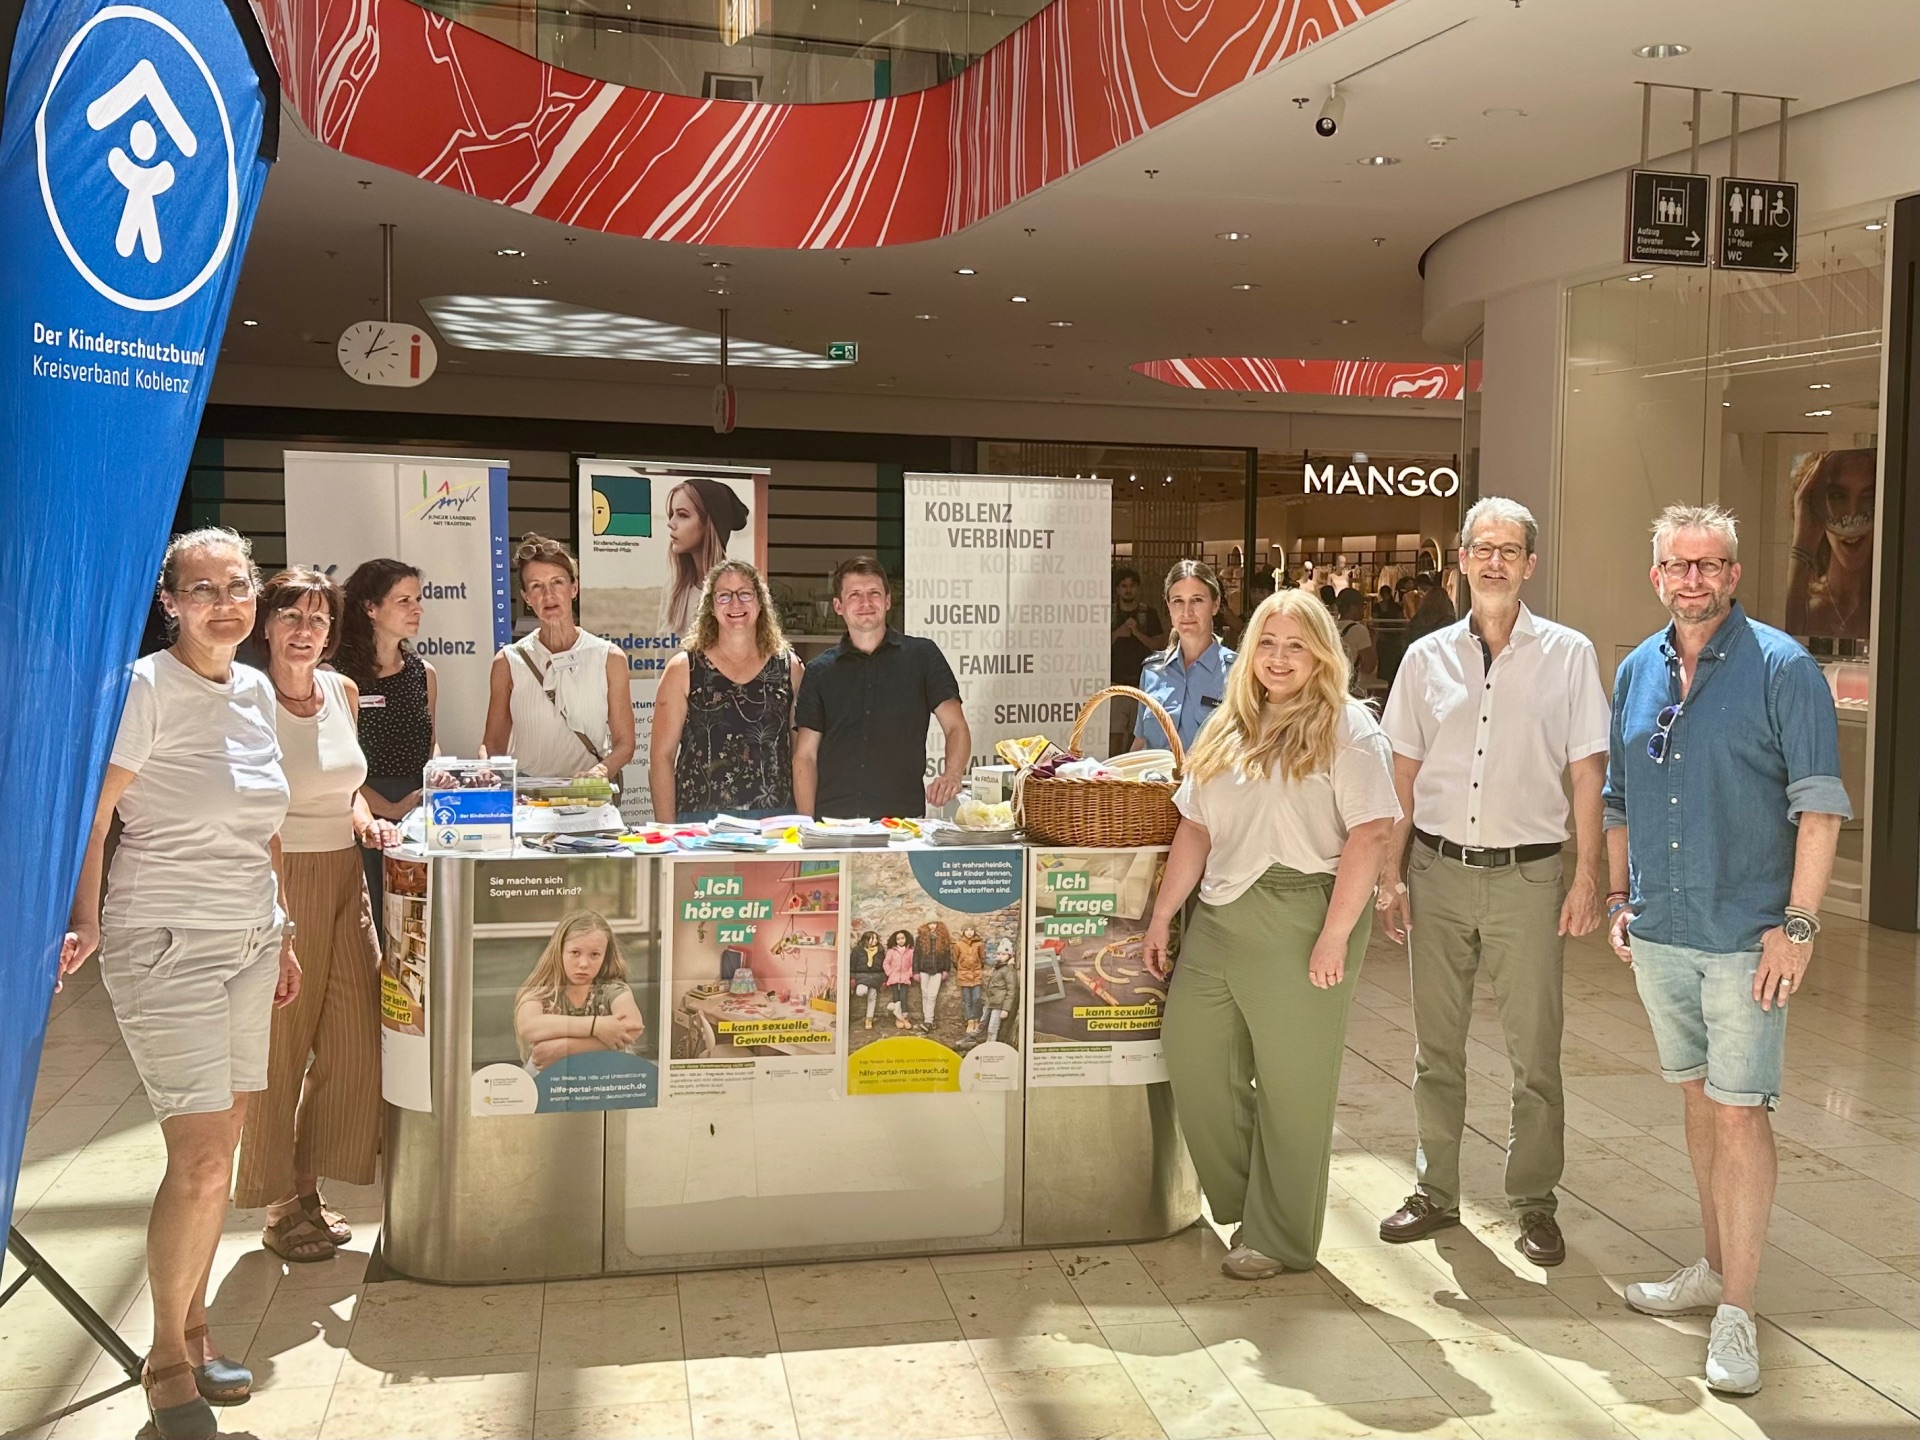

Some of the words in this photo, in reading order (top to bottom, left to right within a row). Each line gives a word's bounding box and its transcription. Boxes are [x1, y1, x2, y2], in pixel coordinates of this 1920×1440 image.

[1637, 237, 1664, 245] Elevator
[1727, 251, 1743, 261] WC
[33, 321, 62, 346] Der
[68, 327, 206, 367] Kinderschutzbund
[33, 354, 130, 387] Kreisverband
[135, 368, 190, 394] Koblenz
[1304, 463, 1459, 497] MANGO
[925, 501, 1013, 523] KOBLENZ
[947, 528, 1055, 549] VERBINDET
[980, 554, 1065, 574] KOBLENZ
[422, 582, 467, 600] damt
[924, 604, 1000, 625] JUGEND
[1008, 604, 1110, 624] VERBINDET
[416, 638, 476, 655] oblenz
[979, 629, 1064, 650] KOBLENZ
[628, 654, 665, 670] lenz
[959, 654, 1034, 675] FAMILIE
[489, 877, 504, 886] Sie
[506, 876, 542, 885] machen
[544, 876, 563, 885] sich
[693, 878, 741, 899] „Ich
[1044, 873, 1087, 893] „Ich
[489, 888, 522, 899] Sorgen
[524, 888, 539, 896] um
[540, 887, 555, 896] ein
[556, 886, 582, 896] Kind?
[684, 902, 734, 920] höre
[738, 902, 770, 919] dir
[1059, 896, 1114, 916] frage
[1114, 1006, 1156, 1017] sexuelle
[761, 1021, 809, 1031] sexuelle
[1089, 1020, 1128, 1030] Gewalt
[735, 1034, 776, 1045] Gewalt
[778, 1033, 831, 1044] beenden.
[550, 1082, 647, 1094] hilfe-portal-missbrauch.de
